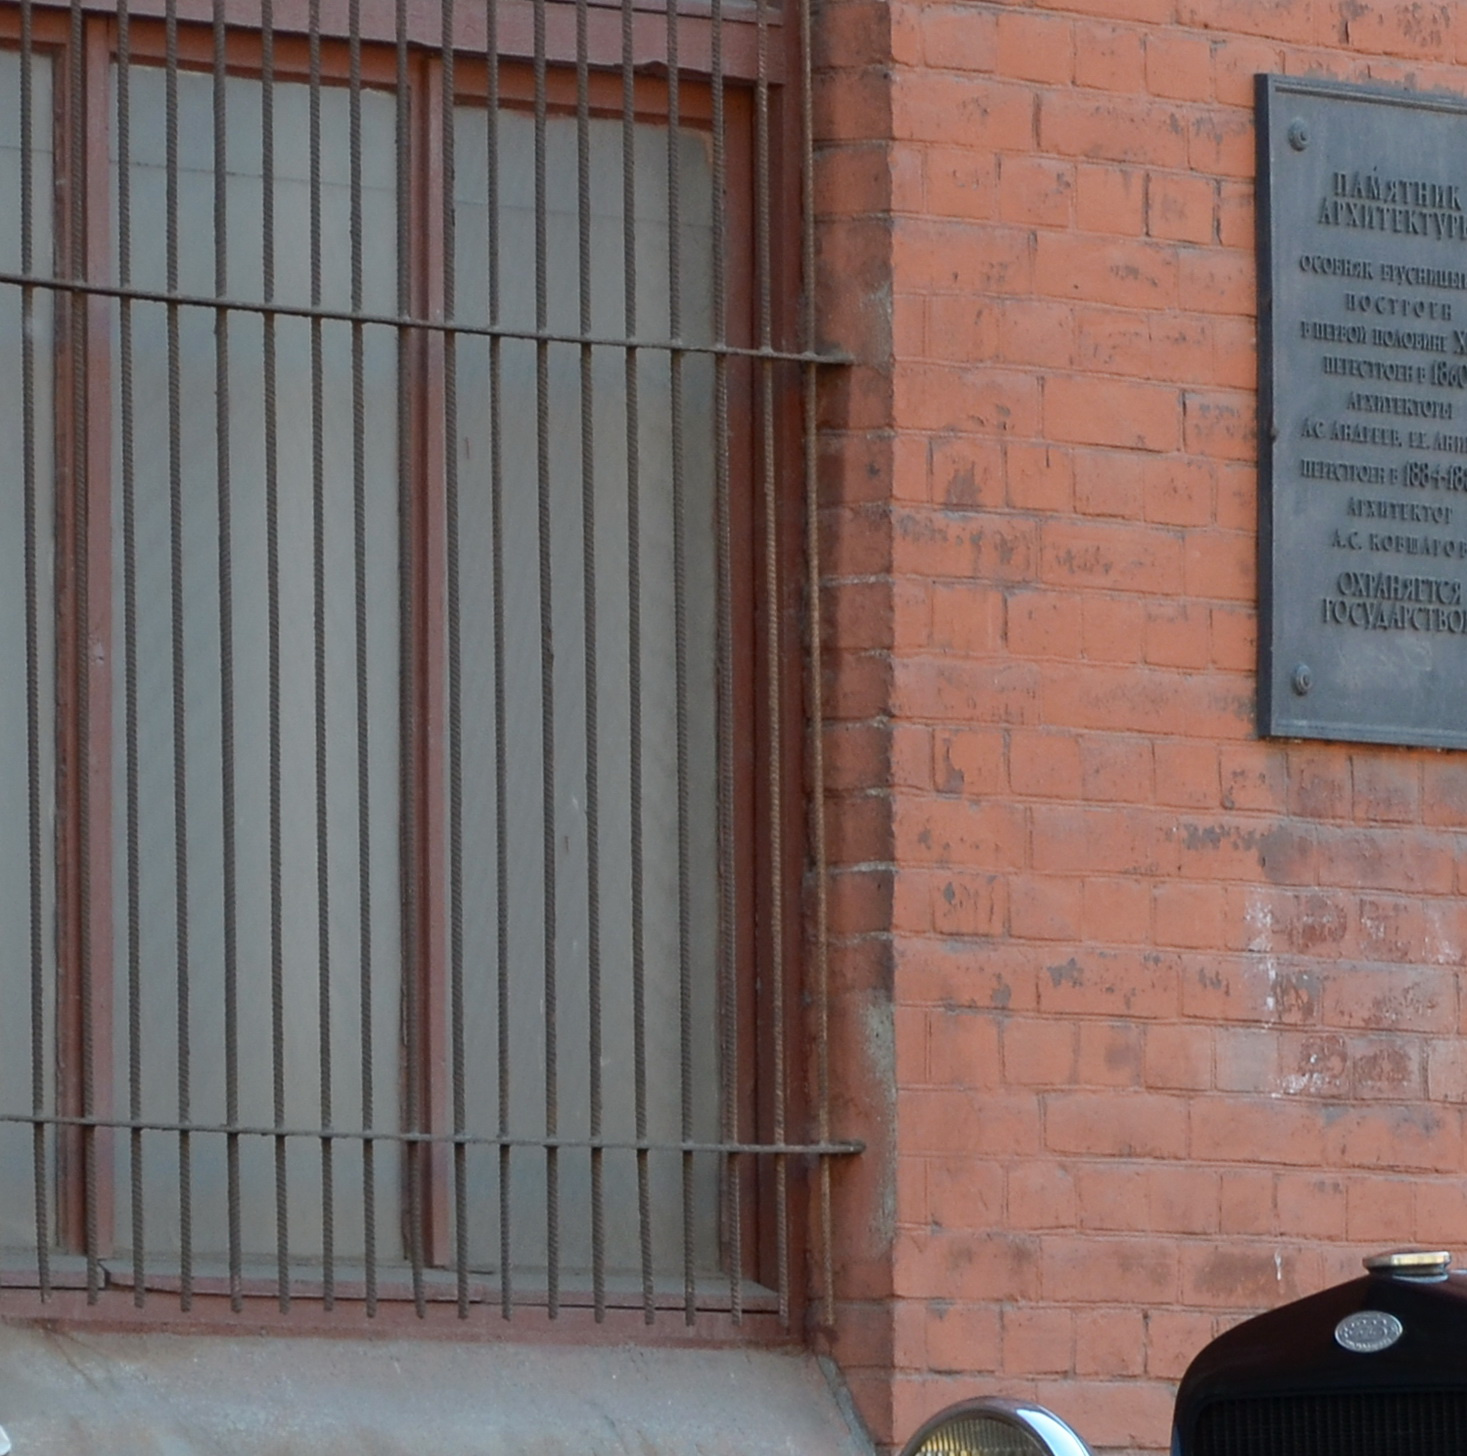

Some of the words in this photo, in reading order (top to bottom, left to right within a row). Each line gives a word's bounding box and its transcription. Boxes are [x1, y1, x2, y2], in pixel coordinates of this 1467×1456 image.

[1333, 171, 1462, 211] ПАМЯТНИК
[1299, 254, 1374, 280] ОСОБНЯК
[1346, 293, 1453, 322] ПОСТРОЕН
[1300, 320, 1310, 339] В
[1313, 321, 1367, 345] ПЕРВОЙ
[1372, 327, 1449, 353] ПОЛОВИНЕ
[1323, 355, 1412, 382] ПЕРЕСТРОЕН
[1417, 366, 1426, 384] В
[1346, 391, 1453, 420] АРХИТЕКТОРЫ
[1300, 459, 1384, 484] ПЕРЕСТРОЕН
[1389, 468, 1398, 485] В
[1346, 497, 1453, 525] АРХИТЕКТОР
[1369, 532, 1467, 559] КОВШАРОВ
[1337, 571, 1462, 605] ОХРАНЯЕТСЯ
